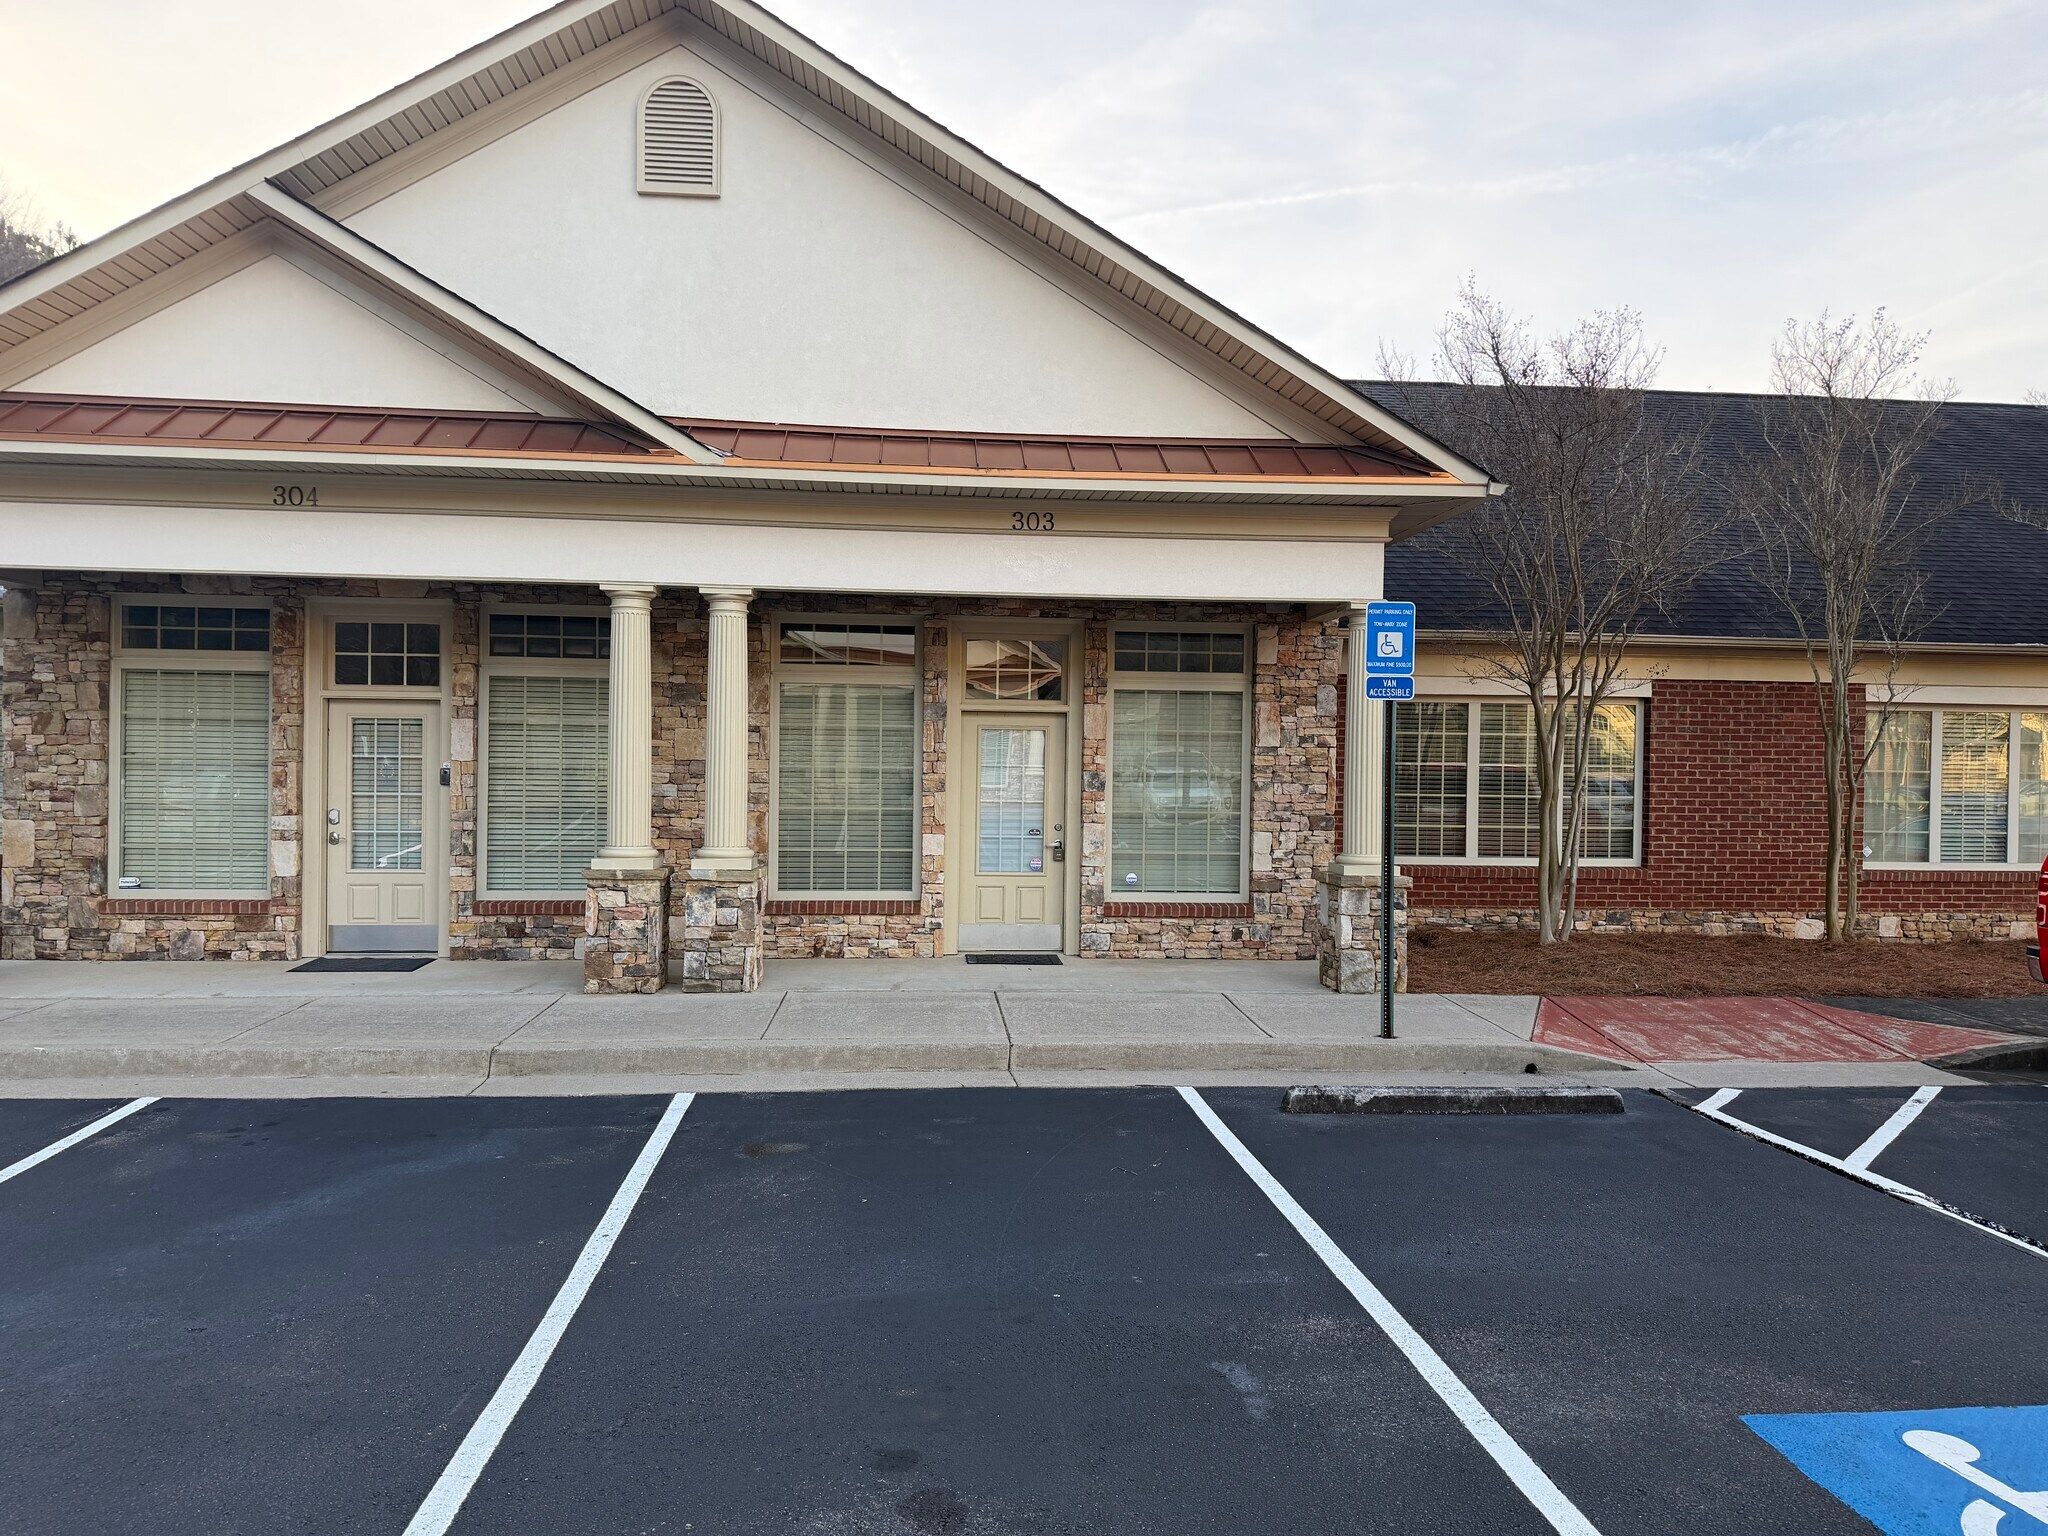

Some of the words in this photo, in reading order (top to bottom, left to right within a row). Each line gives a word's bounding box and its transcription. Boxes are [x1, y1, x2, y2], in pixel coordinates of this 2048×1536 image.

[273, 485, 319, 507] 304
[1012, 511, 1055, 531] 303
[1369, 688, 1411, 697] ACCESSIBLE
